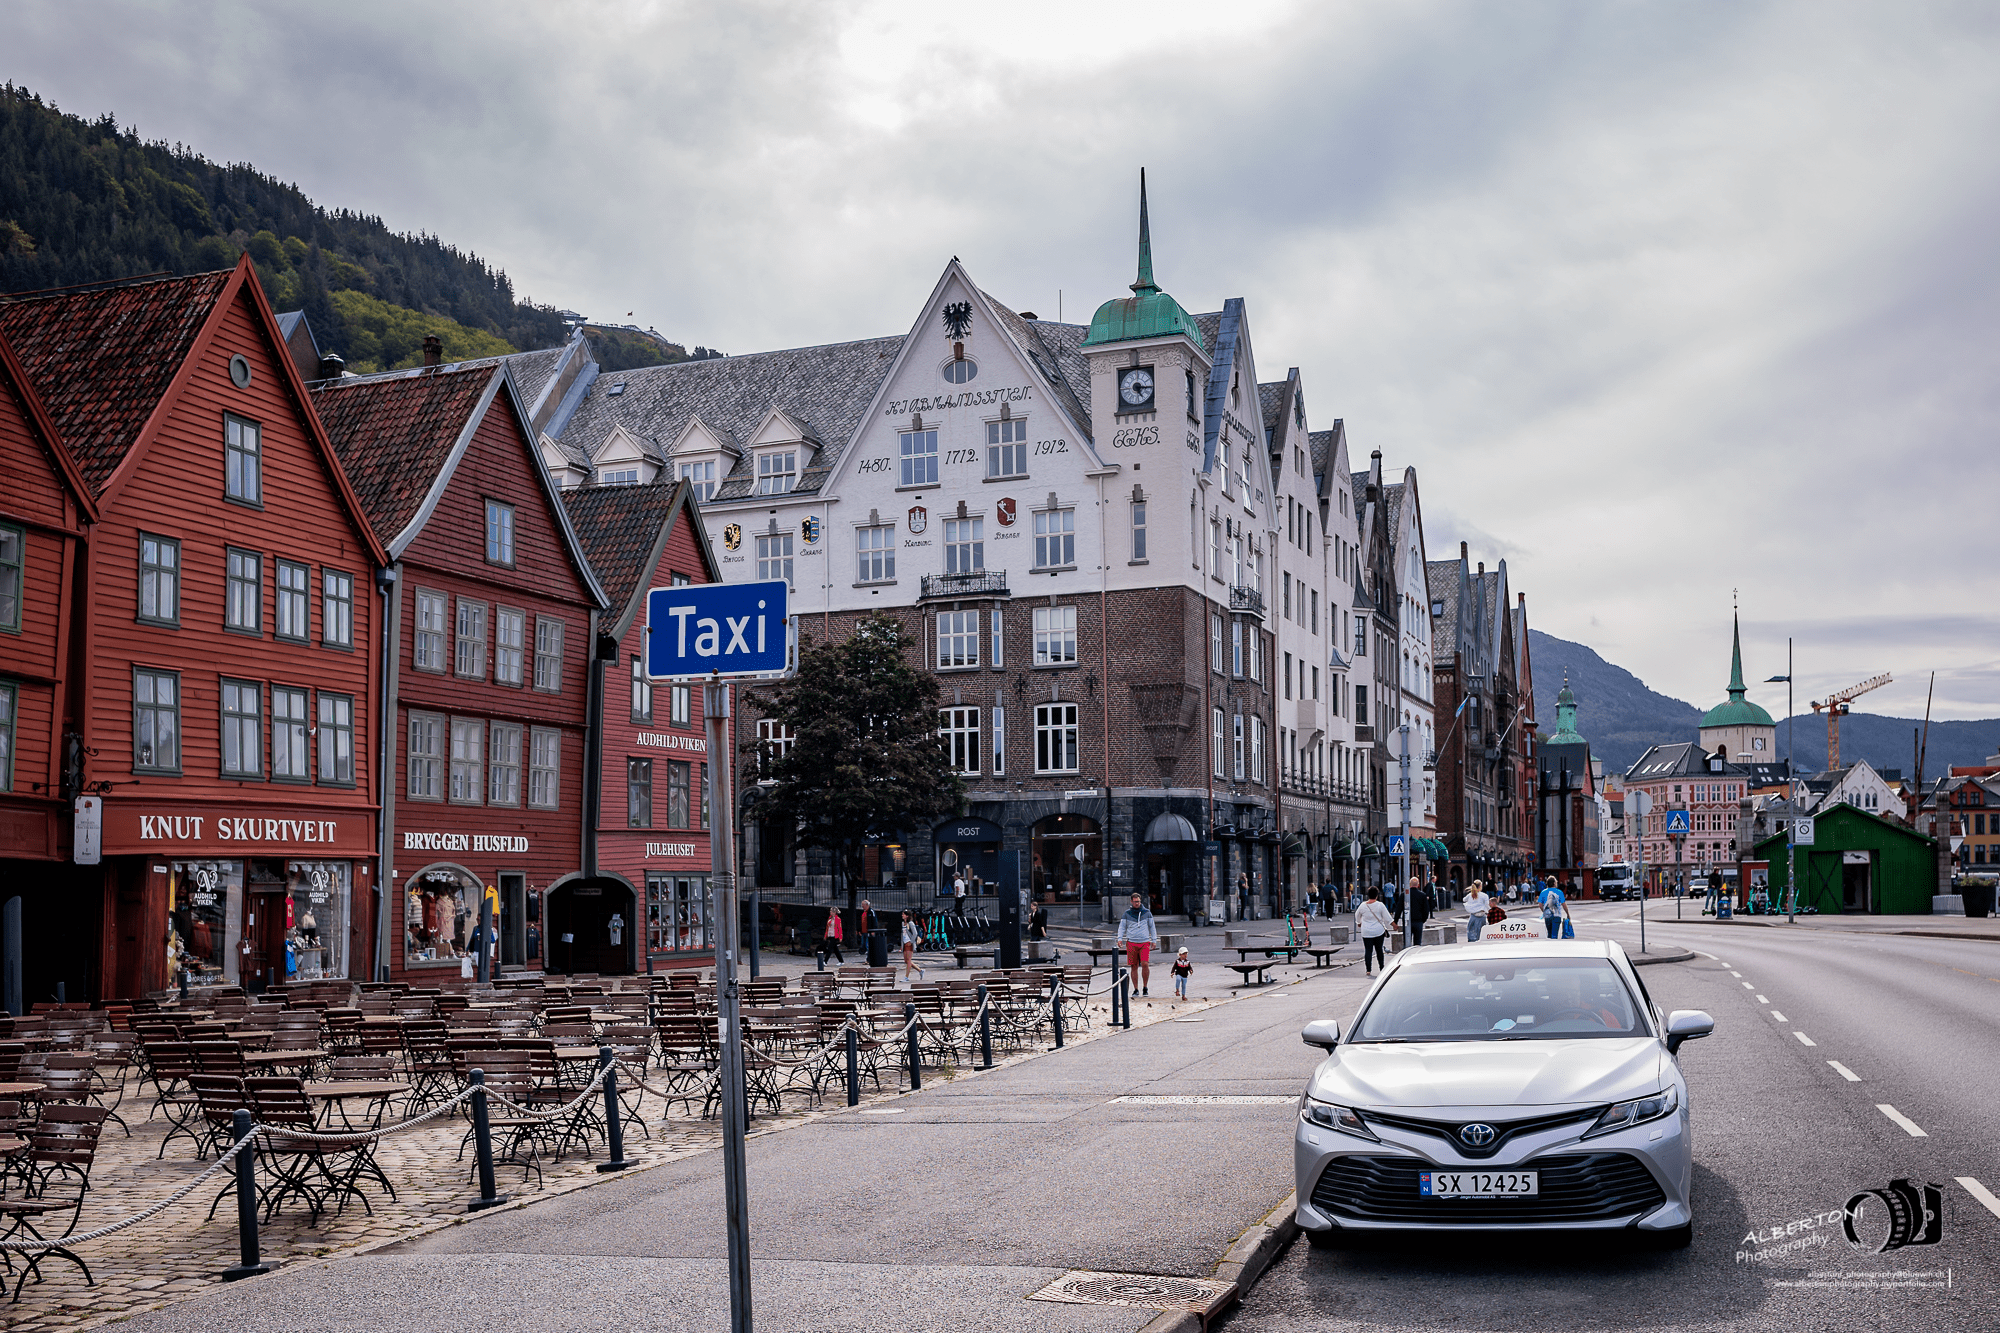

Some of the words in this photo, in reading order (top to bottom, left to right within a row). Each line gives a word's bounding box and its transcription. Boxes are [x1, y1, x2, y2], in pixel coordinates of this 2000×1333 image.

[1035, 439, 1069, 455] 1912.
[857, 457, 892, 474] 1480.
[945, 448, 979, 465] 1712.
[668, 599, 766, 658] Taxi
[636, 732, 678, 749] AUDHILD
[679, 737, 706, 752] VIKEN
[139, 816, 204, 840] KNUT
[217, 817, 337, 843] SKURTVEIT
[404, 832, 469, 851] BRYGGEN
[473, 834, 529, 853] HUSFLID
[645, 842, 696, 859] JULEHUSET
[1500, 924, 1507, 932] R
[1509, 923, 1527, 932] 673
[1437, 1174, 1462, 1193] SX
[1471, 1174, 1531, 1193] 12425
